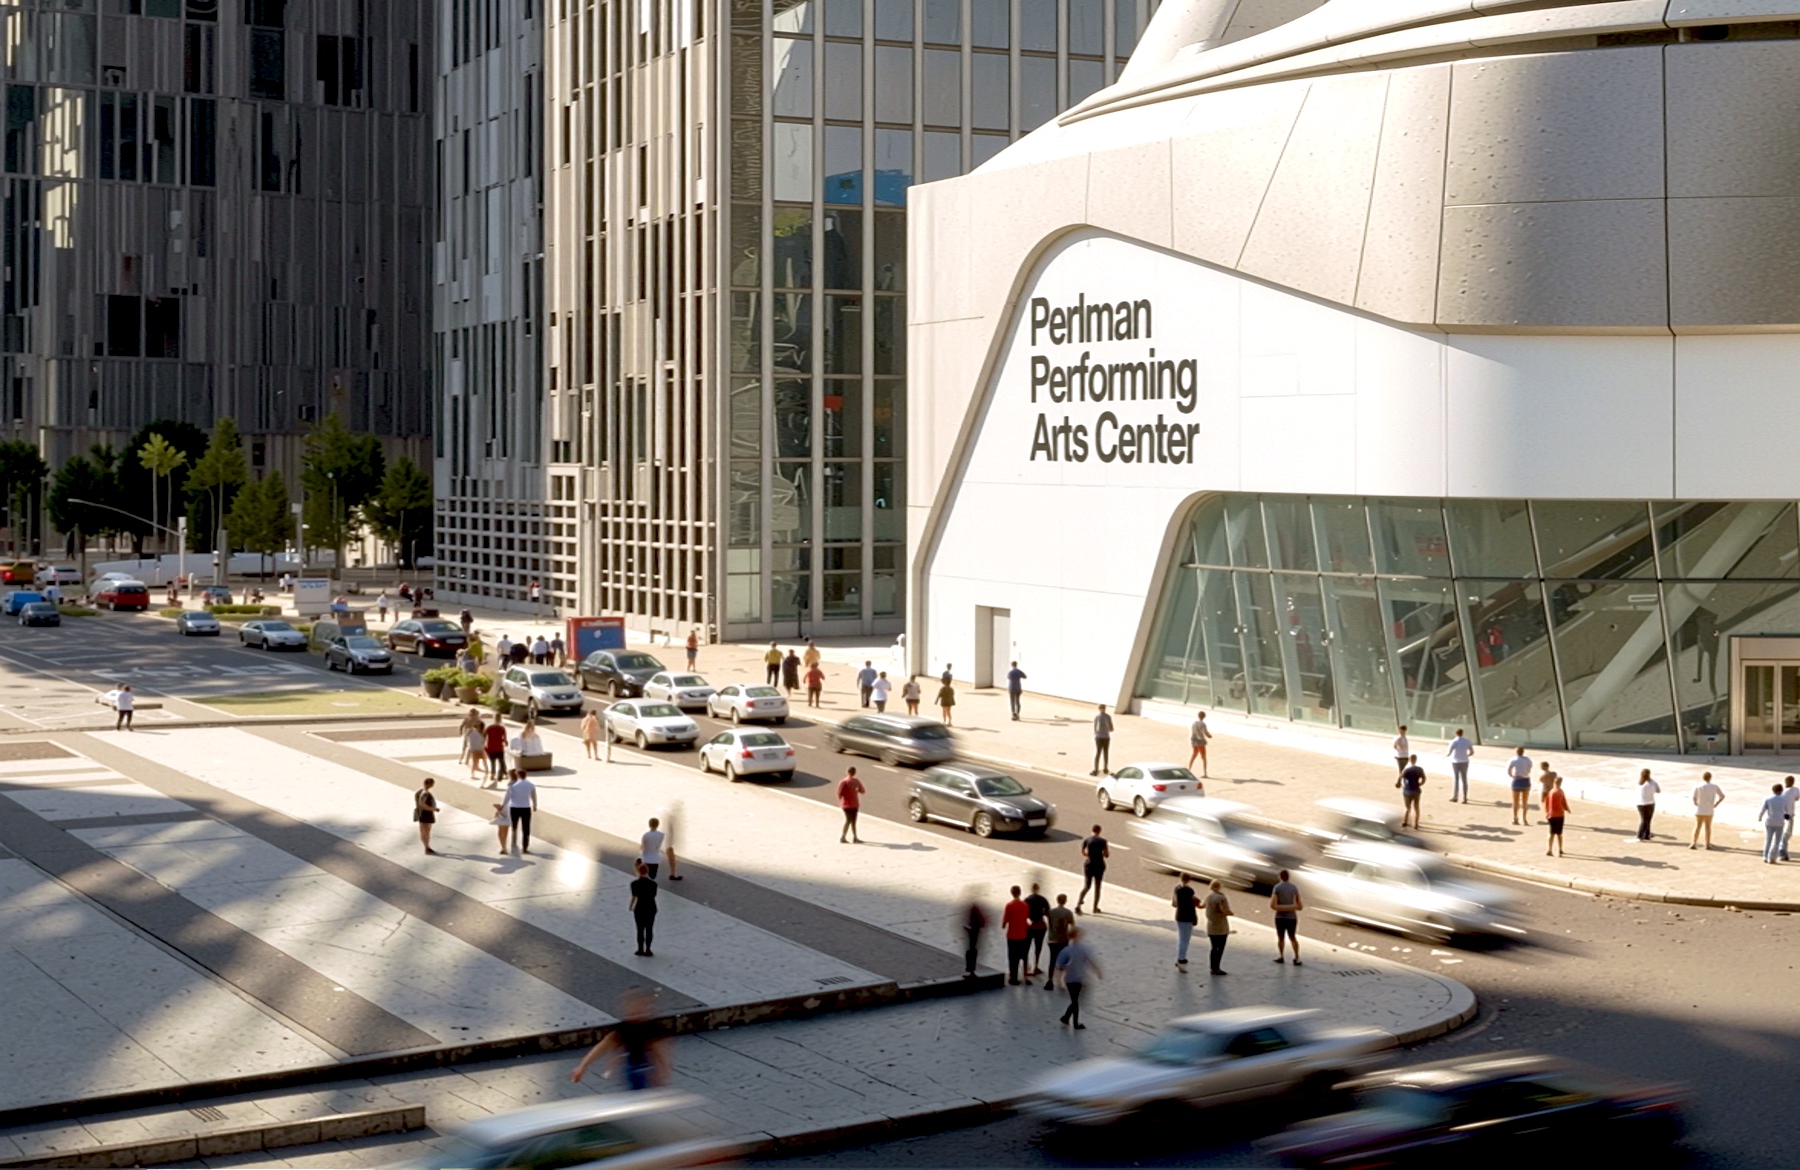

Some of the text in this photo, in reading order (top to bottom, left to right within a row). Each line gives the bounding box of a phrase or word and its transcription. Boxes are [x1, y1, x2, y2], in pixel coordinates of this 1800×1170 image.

[1031, 292, 1152, 347] Perlman
[1031, 347, 1198, 414] Performing
[1030, 410, 1200, 465] Arts Center
